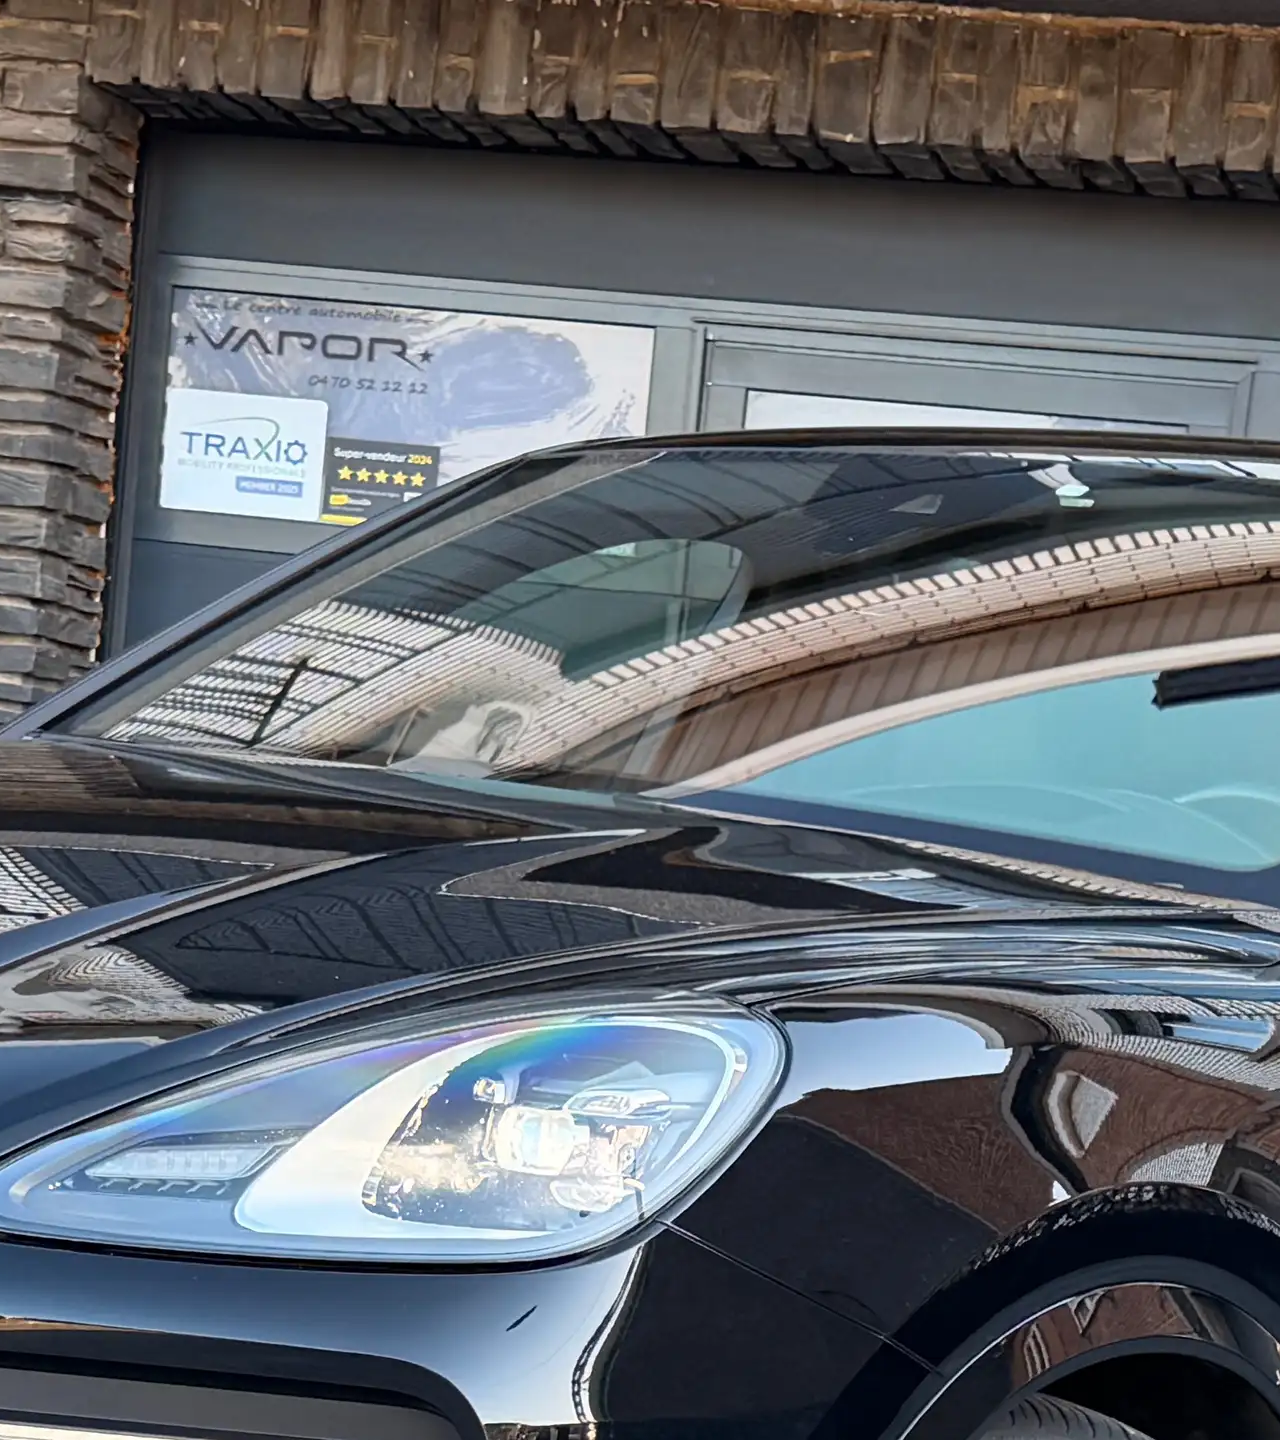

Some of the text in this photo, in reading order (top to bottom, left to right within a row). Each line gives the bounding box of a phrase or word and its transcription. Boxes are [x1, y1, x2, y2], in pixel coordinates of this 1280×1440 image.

[249, 302, 301, 317] centre
[309, 309, 402, 323] automobile
[195, 316, 425, 371] VAPOR
[355, 379, 376, 391] 52
[384, 381, 404, 393] 12
[408, 383, 429, 395] 12
[180, 423, 308, 465] TRAXIO
